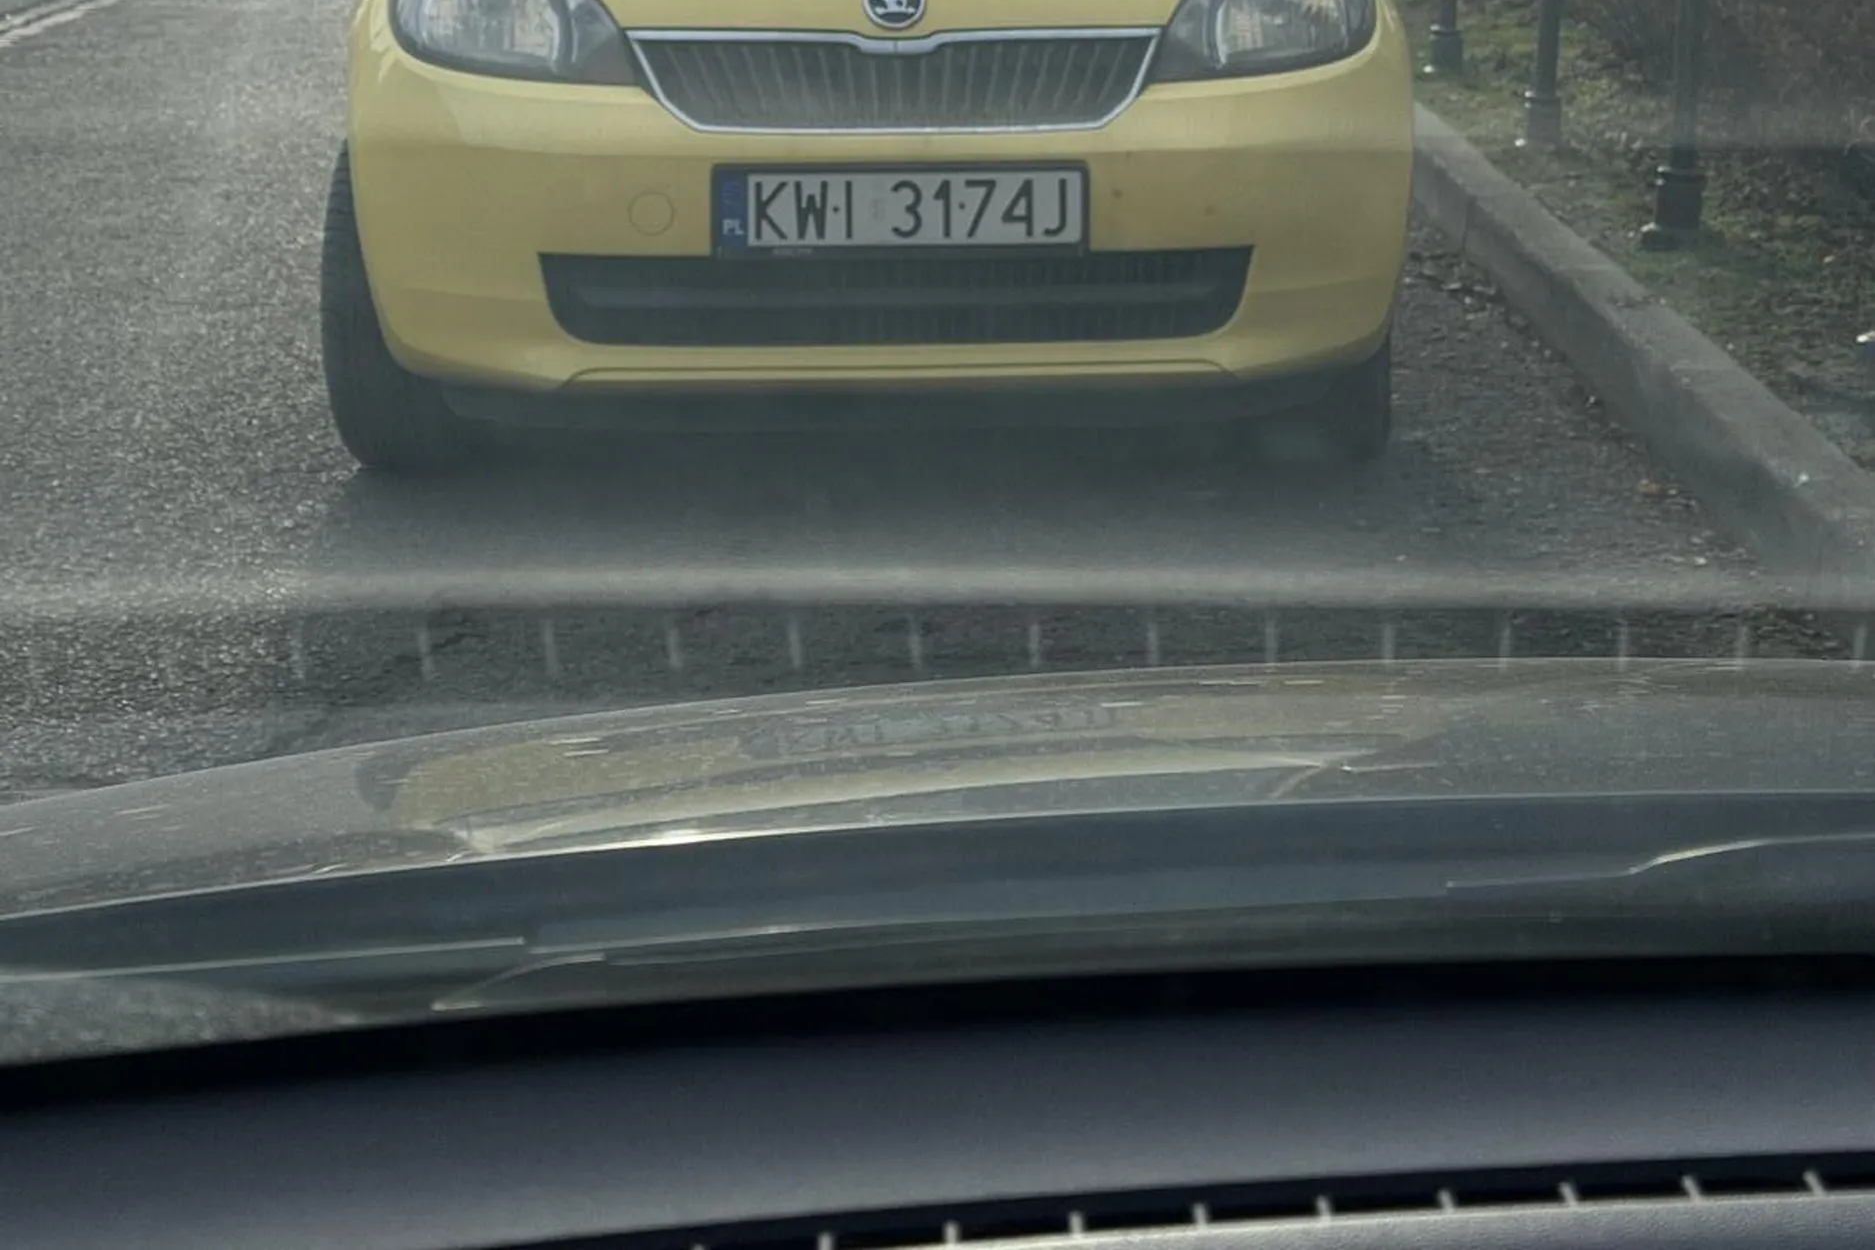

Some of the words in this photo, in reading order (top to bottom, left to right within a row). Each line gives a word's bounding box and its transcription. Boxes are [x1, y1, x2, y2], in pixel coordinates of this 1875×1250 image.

[722, 219, 744, 235] PL
[754, 180, 853, 240] KWI
[890, 178, 1068, 238] 3174J
